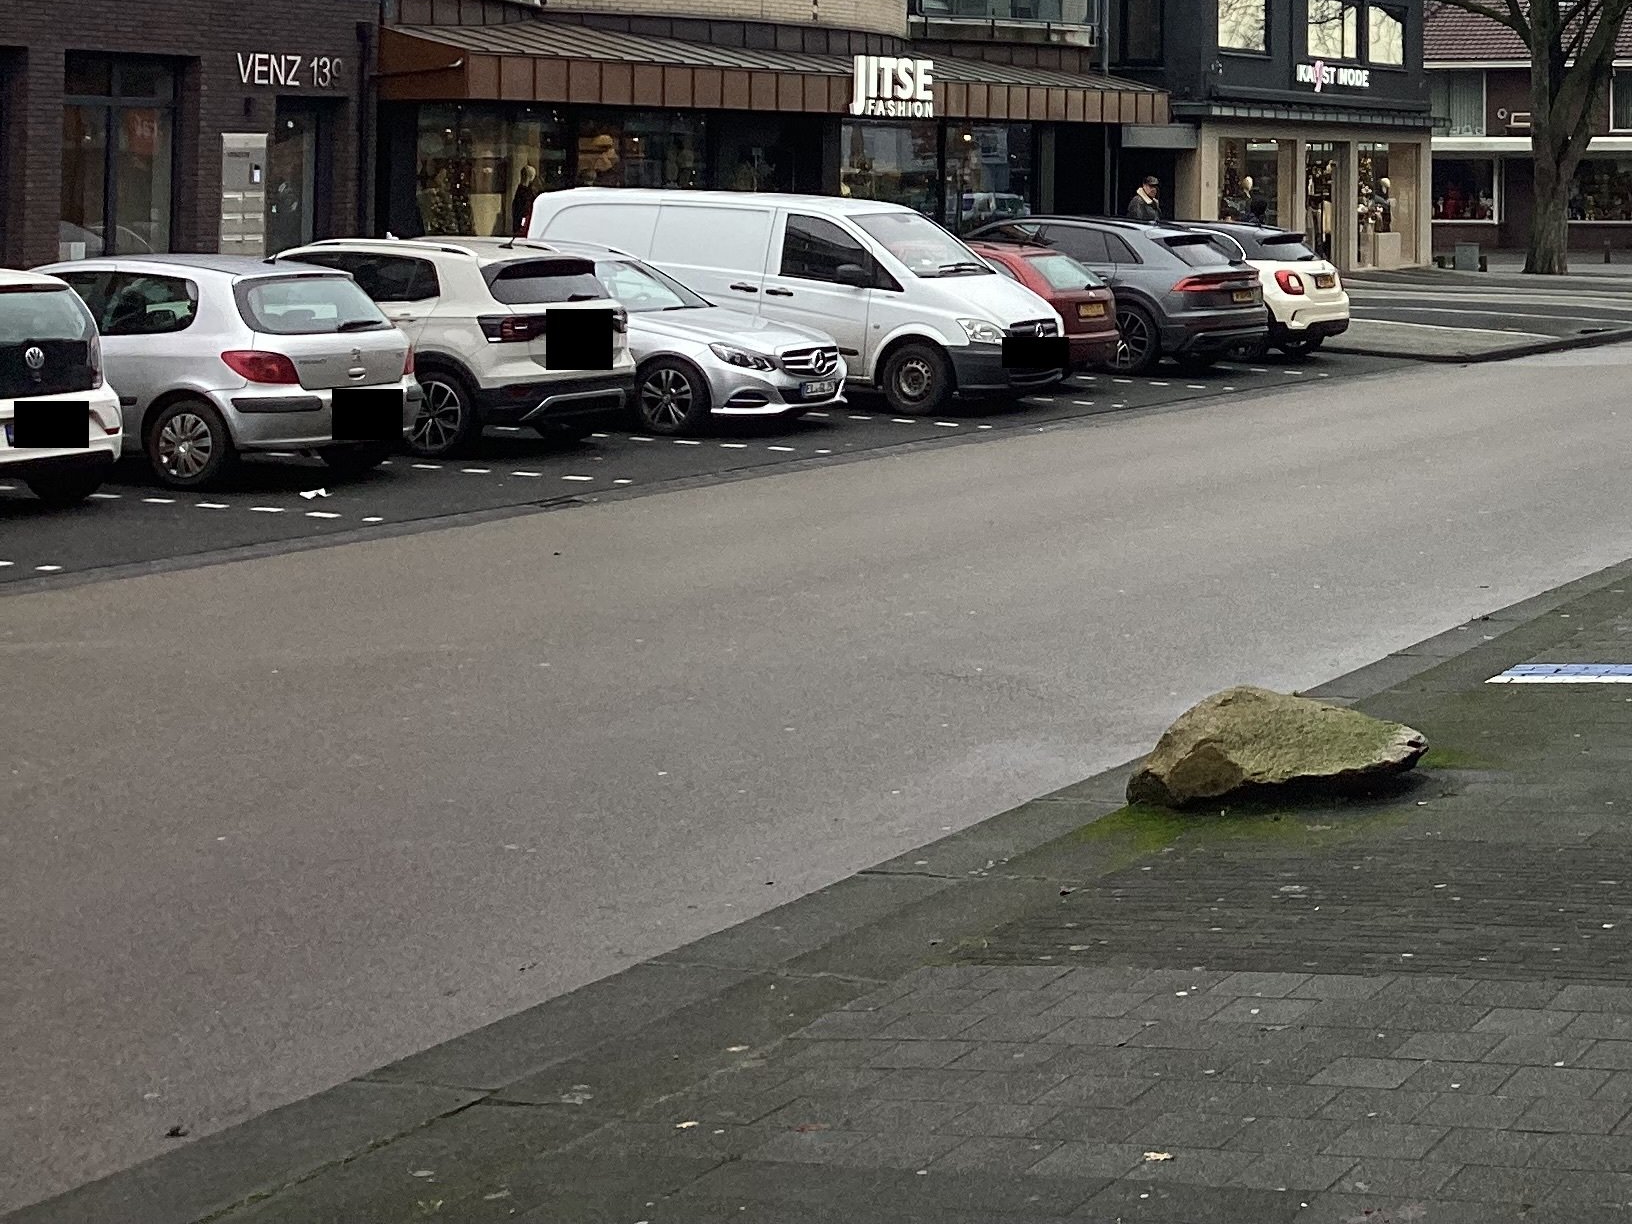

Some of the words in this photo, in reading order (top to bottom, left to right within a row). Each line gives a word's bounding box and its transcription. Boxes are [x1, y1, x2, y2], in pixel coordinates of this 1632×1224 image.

[237, 52, 302, 86] VENZ
[1337, 67, 1370, 87] MODE
[849, 55, 934, 115] JITSE
[867, 99, 934, 117] FASHION
